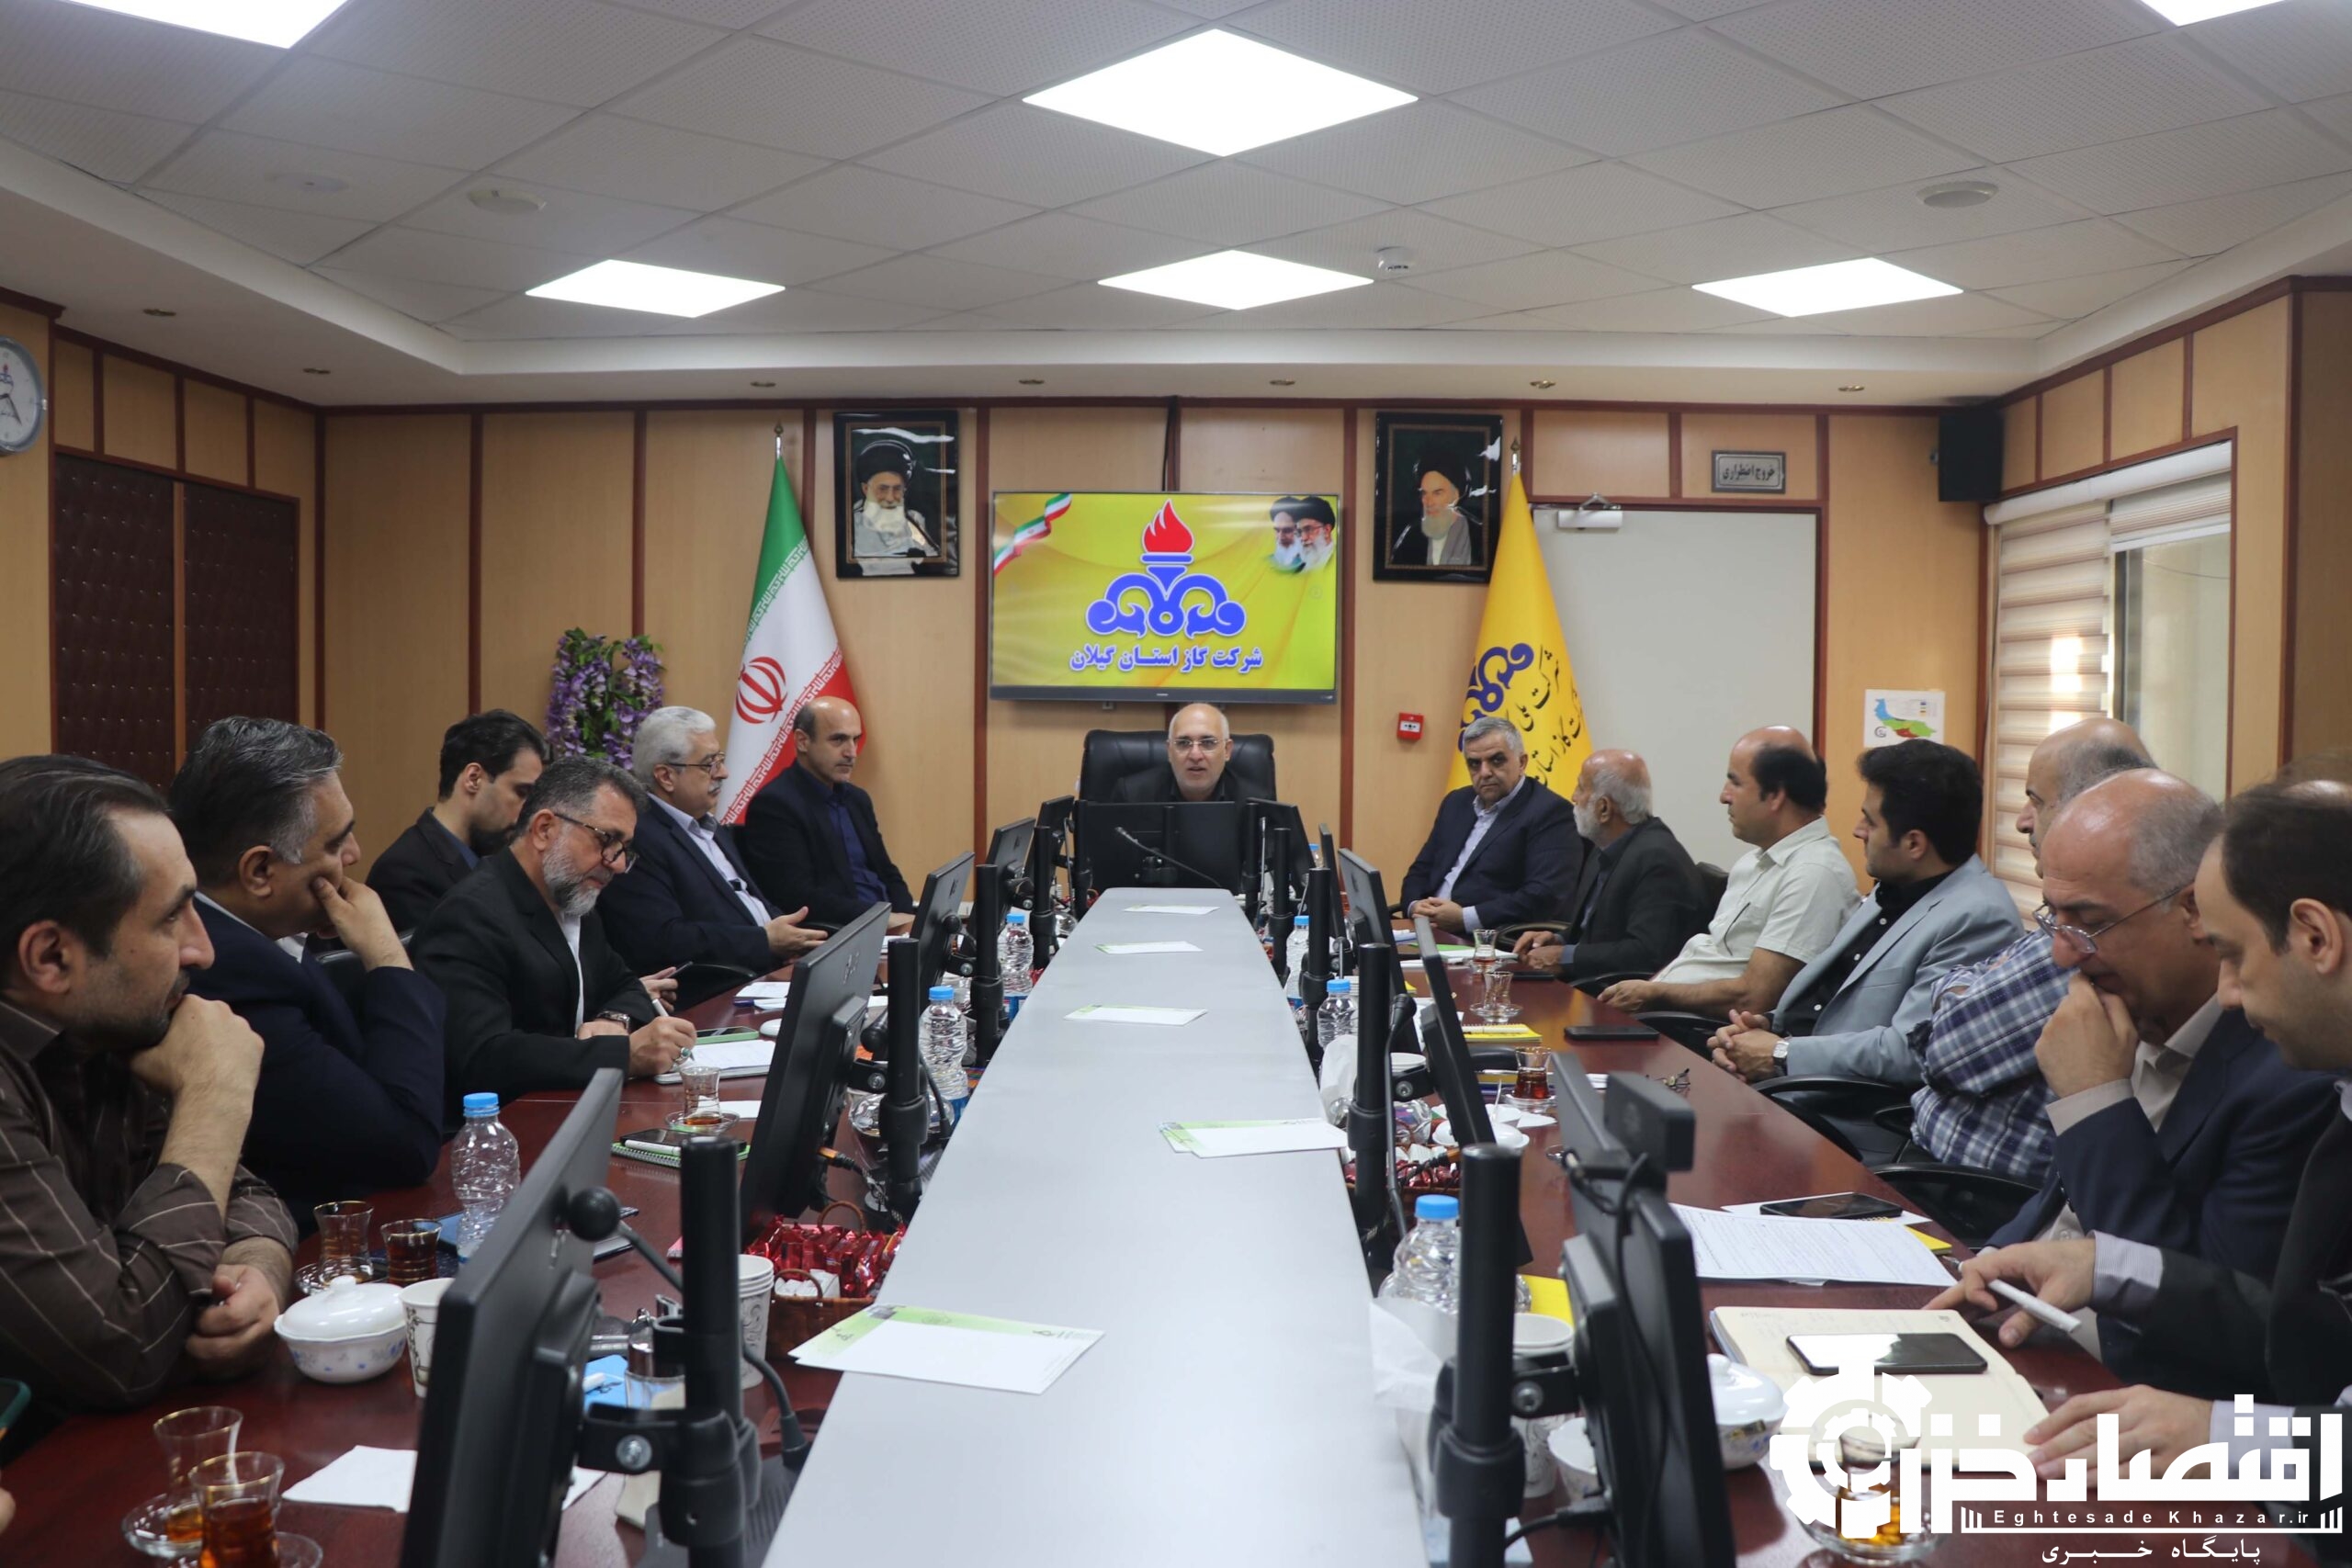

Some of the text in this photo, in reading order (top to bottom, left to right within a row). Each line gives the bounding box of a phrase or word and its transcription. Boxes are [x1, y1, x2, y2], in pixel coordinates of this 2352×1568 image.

[1722, 463, 1775, 481] خروج اضطراری
[1069, 644, 1262, 674] شرکت گاز استان گیلان
